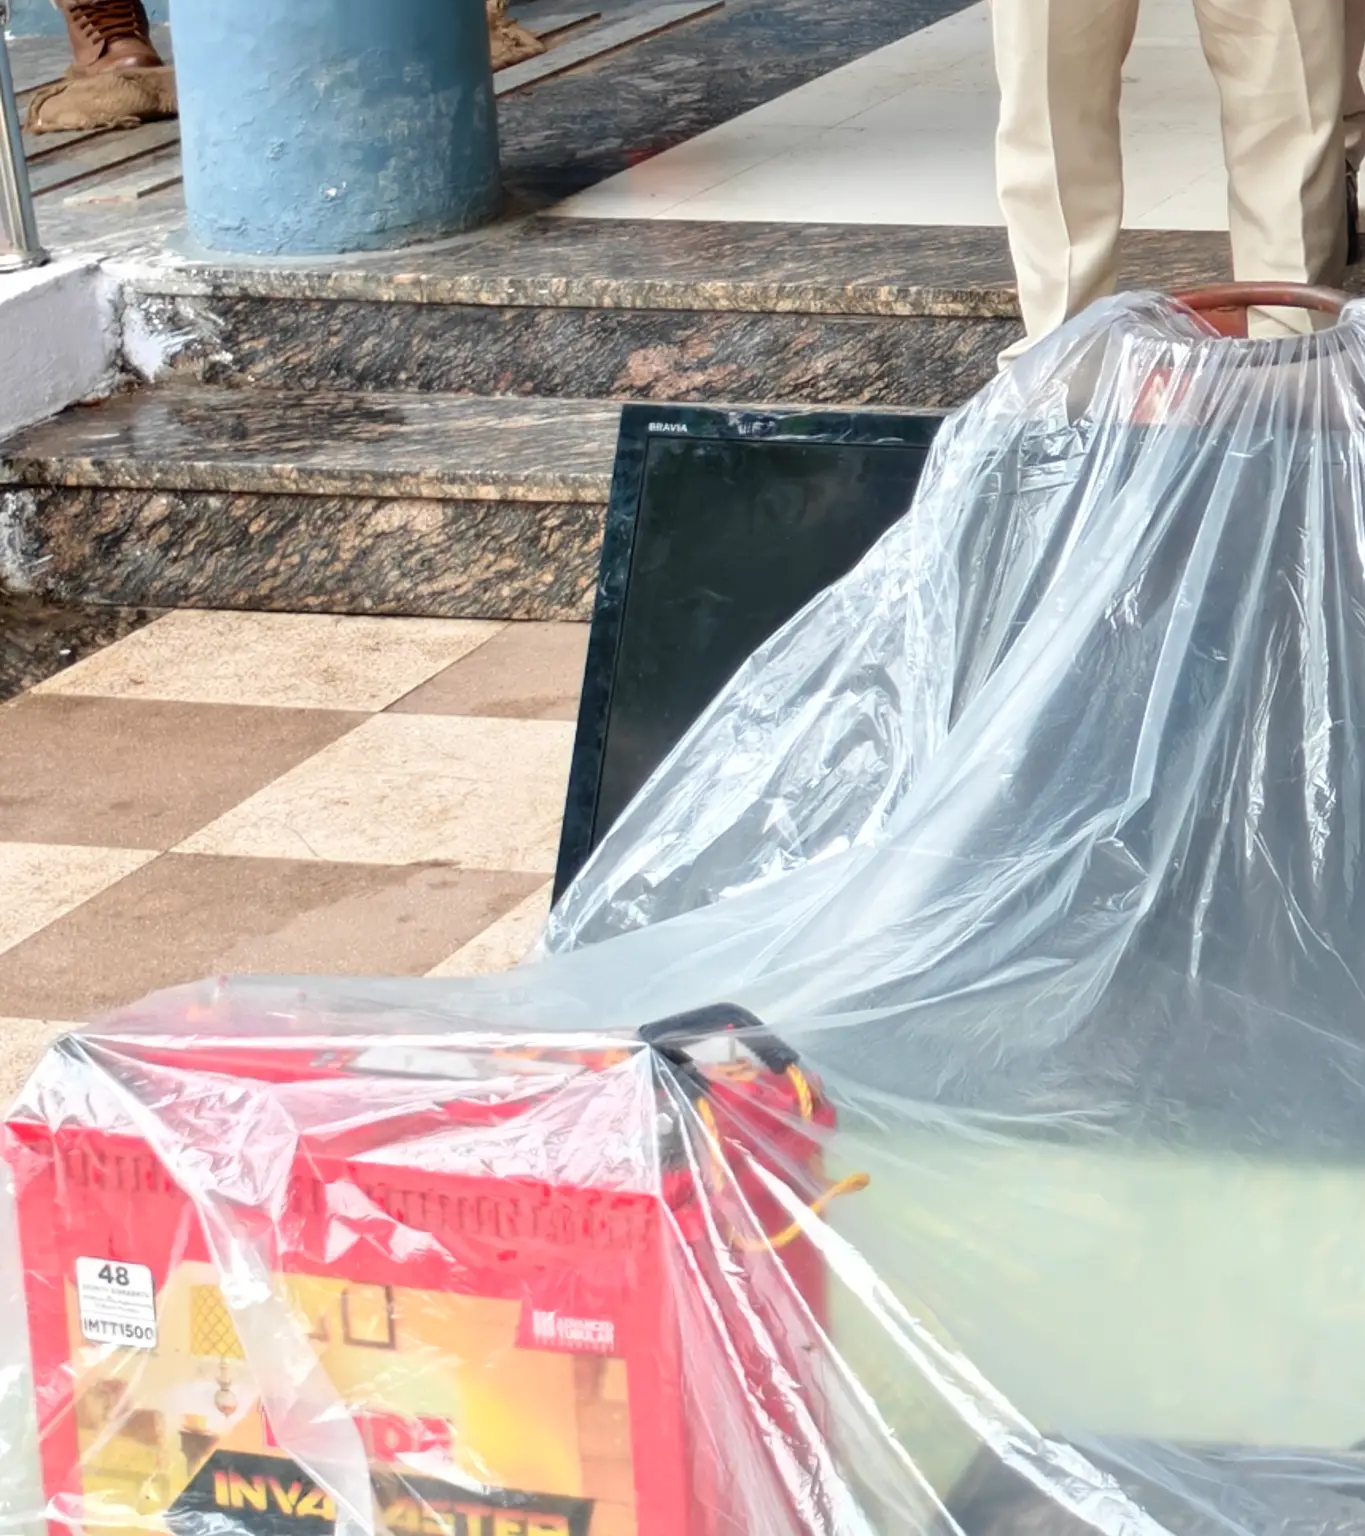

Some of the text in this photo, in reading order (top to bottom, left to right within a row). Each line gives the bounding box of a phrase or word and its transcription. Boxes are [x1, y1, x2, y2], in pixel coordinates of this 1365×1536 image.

[648, 421, 689, 434] BRAVIA
[98, 1263, 130, 1286] 48
[83, 1316, 155, 1341] IMTT1500
